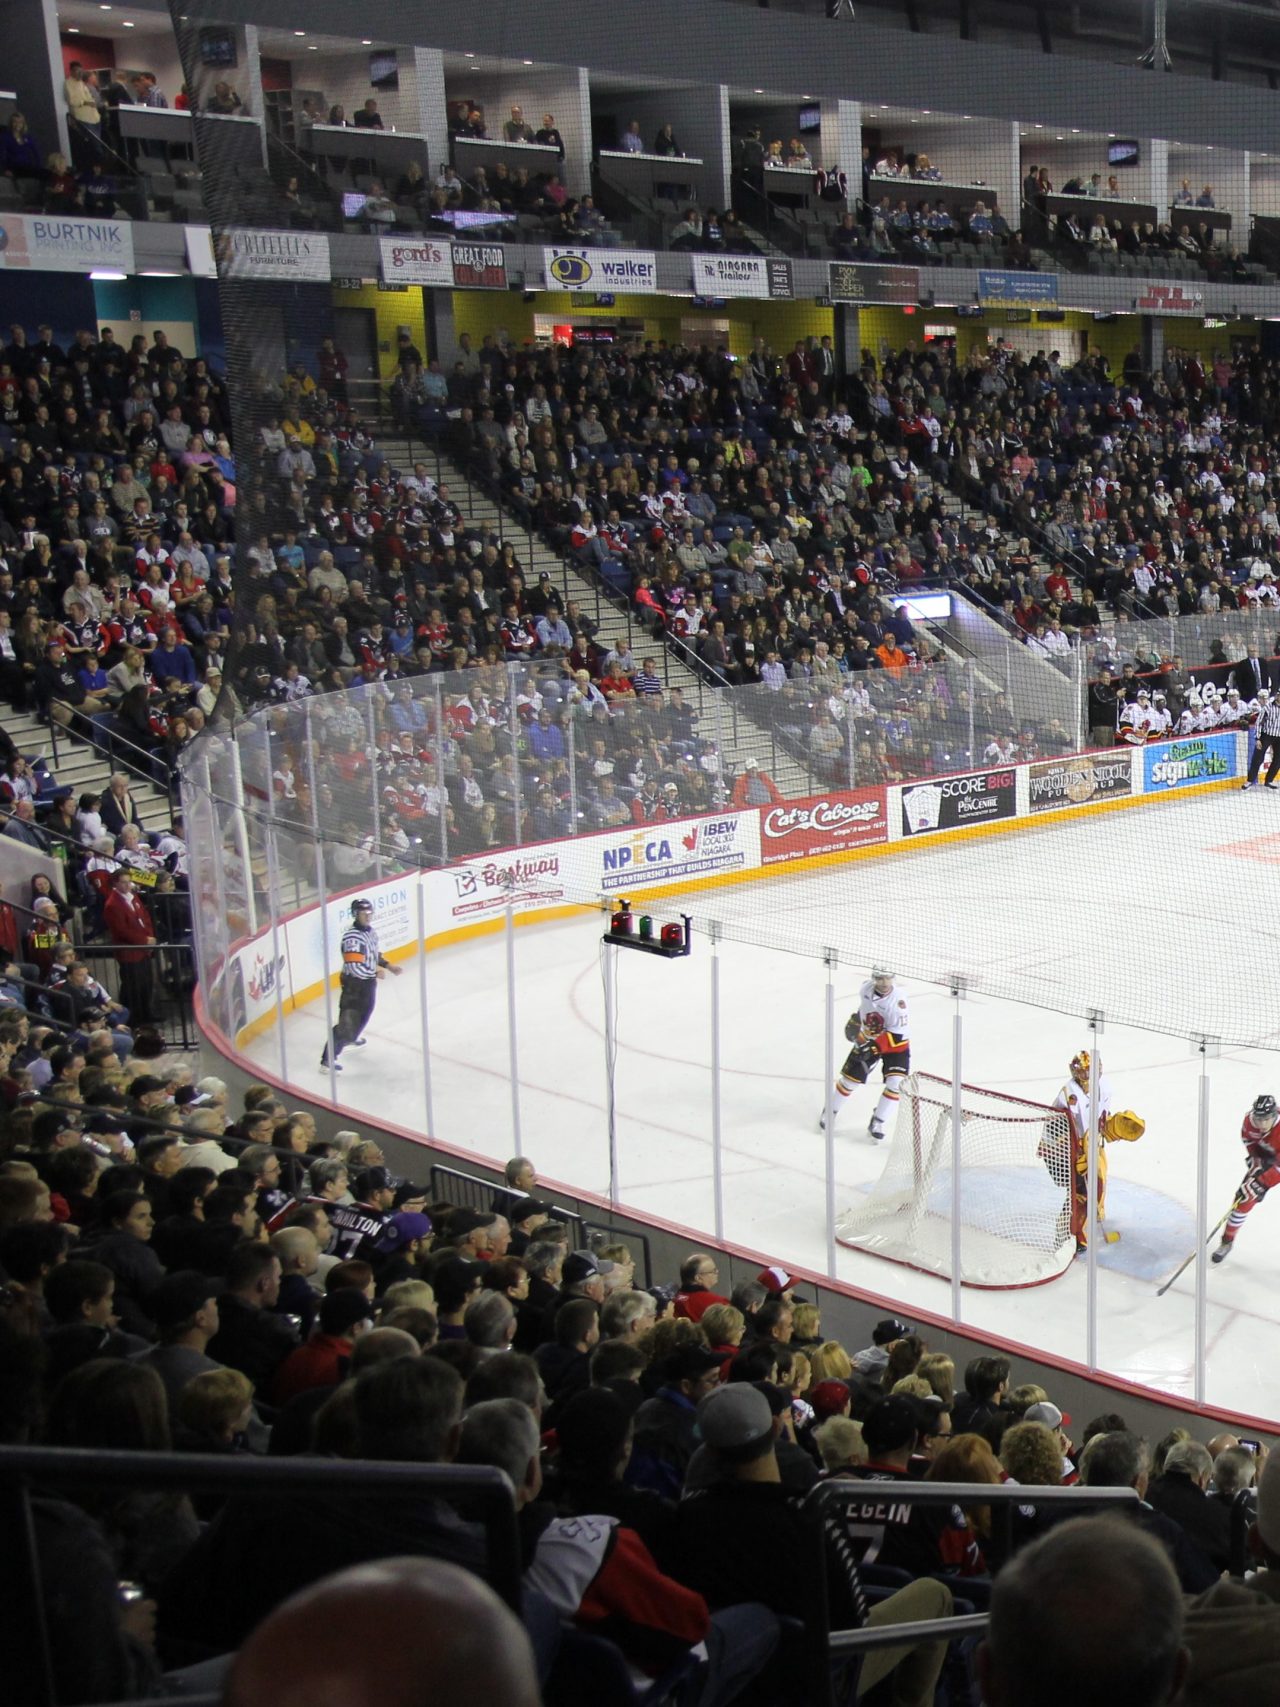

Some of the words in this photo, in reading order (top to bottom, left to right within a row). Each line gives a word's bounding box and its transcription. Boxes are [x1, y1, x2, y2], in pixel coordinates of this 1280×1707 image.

[33, 222, 121, 241] BURTNIK
[36, 239, 94, 252] PRINTING
[392, 243, 442, 267] gord's
[250, 257, 299, 266] FURNITURE
[453, 246, 479, 265] GREAT
[482, 248, 503, 266] FOOD
[601, 260, 653, 277] walker
[718, 260, 760, 272] NIAGARA
[719, 271, 750, 280] Trailers
[605, 278, 653, 286] industries
[1152, 751, 1227, 786] signworks
[943, 776, 986, 797] SCORE
[987, 773, 1014, 789] BIG!
[809, 801, 880, 831] Caboose
[703, 820, 737, 836] IBEW
[703, 836, 722, 846] LOCAL
[603, 840, 672, 871] NPECA
[701, 846, 731, 857] NIAGARA
[481, 857, 559, 887] Bestway
[604, 877, 617, 888] THE
[618, 868, 666, 886] PARTNERSHIP
[668, 866, 685, 876] THAT
[687, 861, 711, 873] BUILDS
[713, 855, 743, 867] NIAGARA
[847, 1523, 886, 1564] 7
